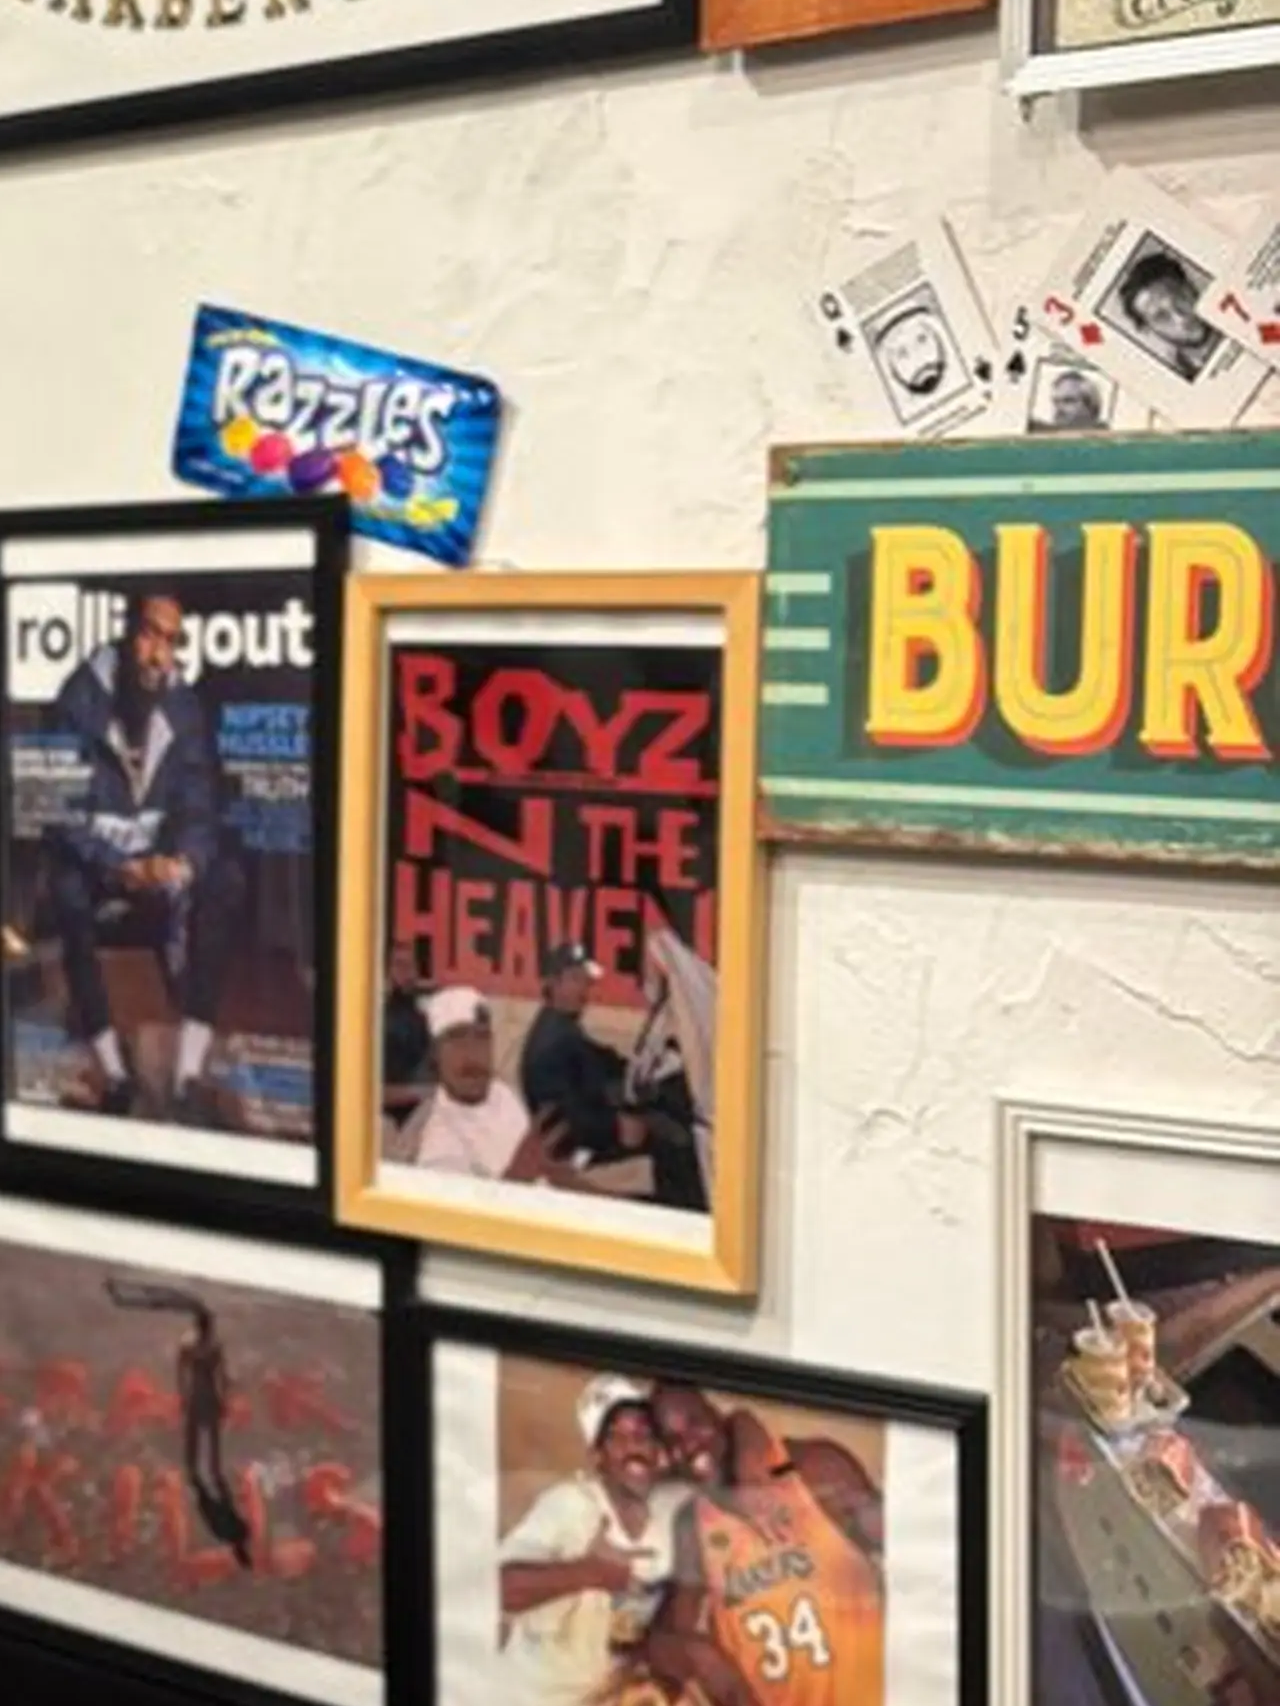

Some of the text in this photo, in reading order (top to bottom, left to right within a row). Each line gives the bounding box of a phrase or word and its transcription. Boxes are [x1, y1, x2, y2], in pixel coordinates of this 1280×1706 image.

[1011, 304, 1032, 342] 5
[1044, 295, 1076, 327] 3
[1218, 292, 1252, 325] 7
[864, 521, 1273, 761] BUR
[398, 652, 711, 784] BOYZ
[404, 787, 555, 877] N
[580, 805, 700, 889] THE
[745, 1594, 834, 1682] 34
